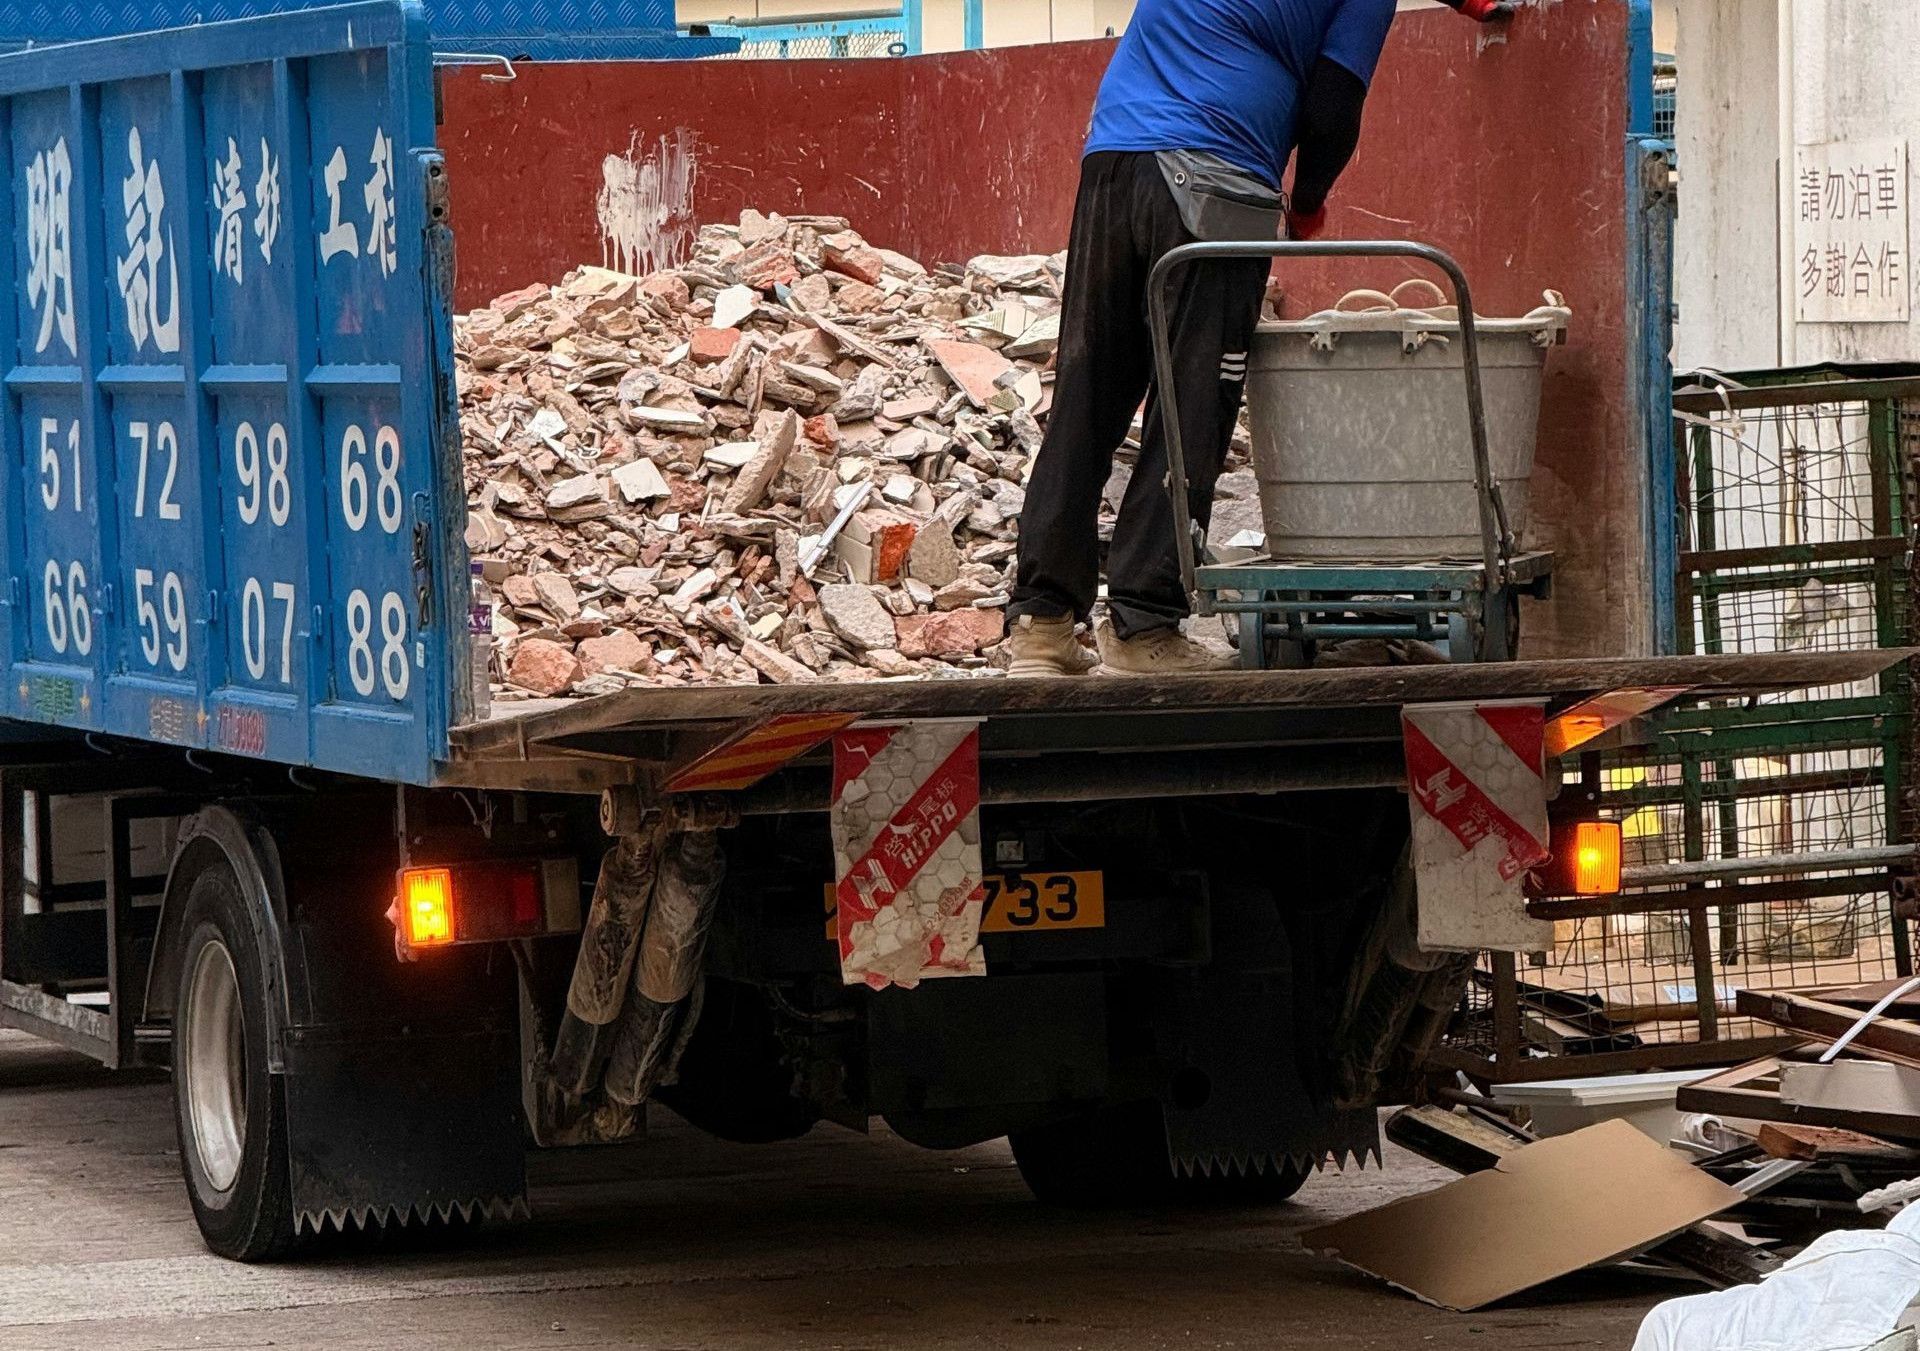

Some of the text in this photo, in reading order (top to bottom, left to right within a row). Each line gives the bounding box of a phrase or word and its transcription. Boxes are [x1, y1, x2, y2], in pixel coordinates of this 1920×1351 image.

[1800, 163, 1898, 222] 請勿泊車
[1802, 241, 1899, 297] 多謝合作
[42, 419, 401, 533] 51 72 98 68
[45, 561, 409, 699] 66 59 07 88
[901, 801, 957, 869] HIPPO
[1458, 818, 1520, 873] HIO
